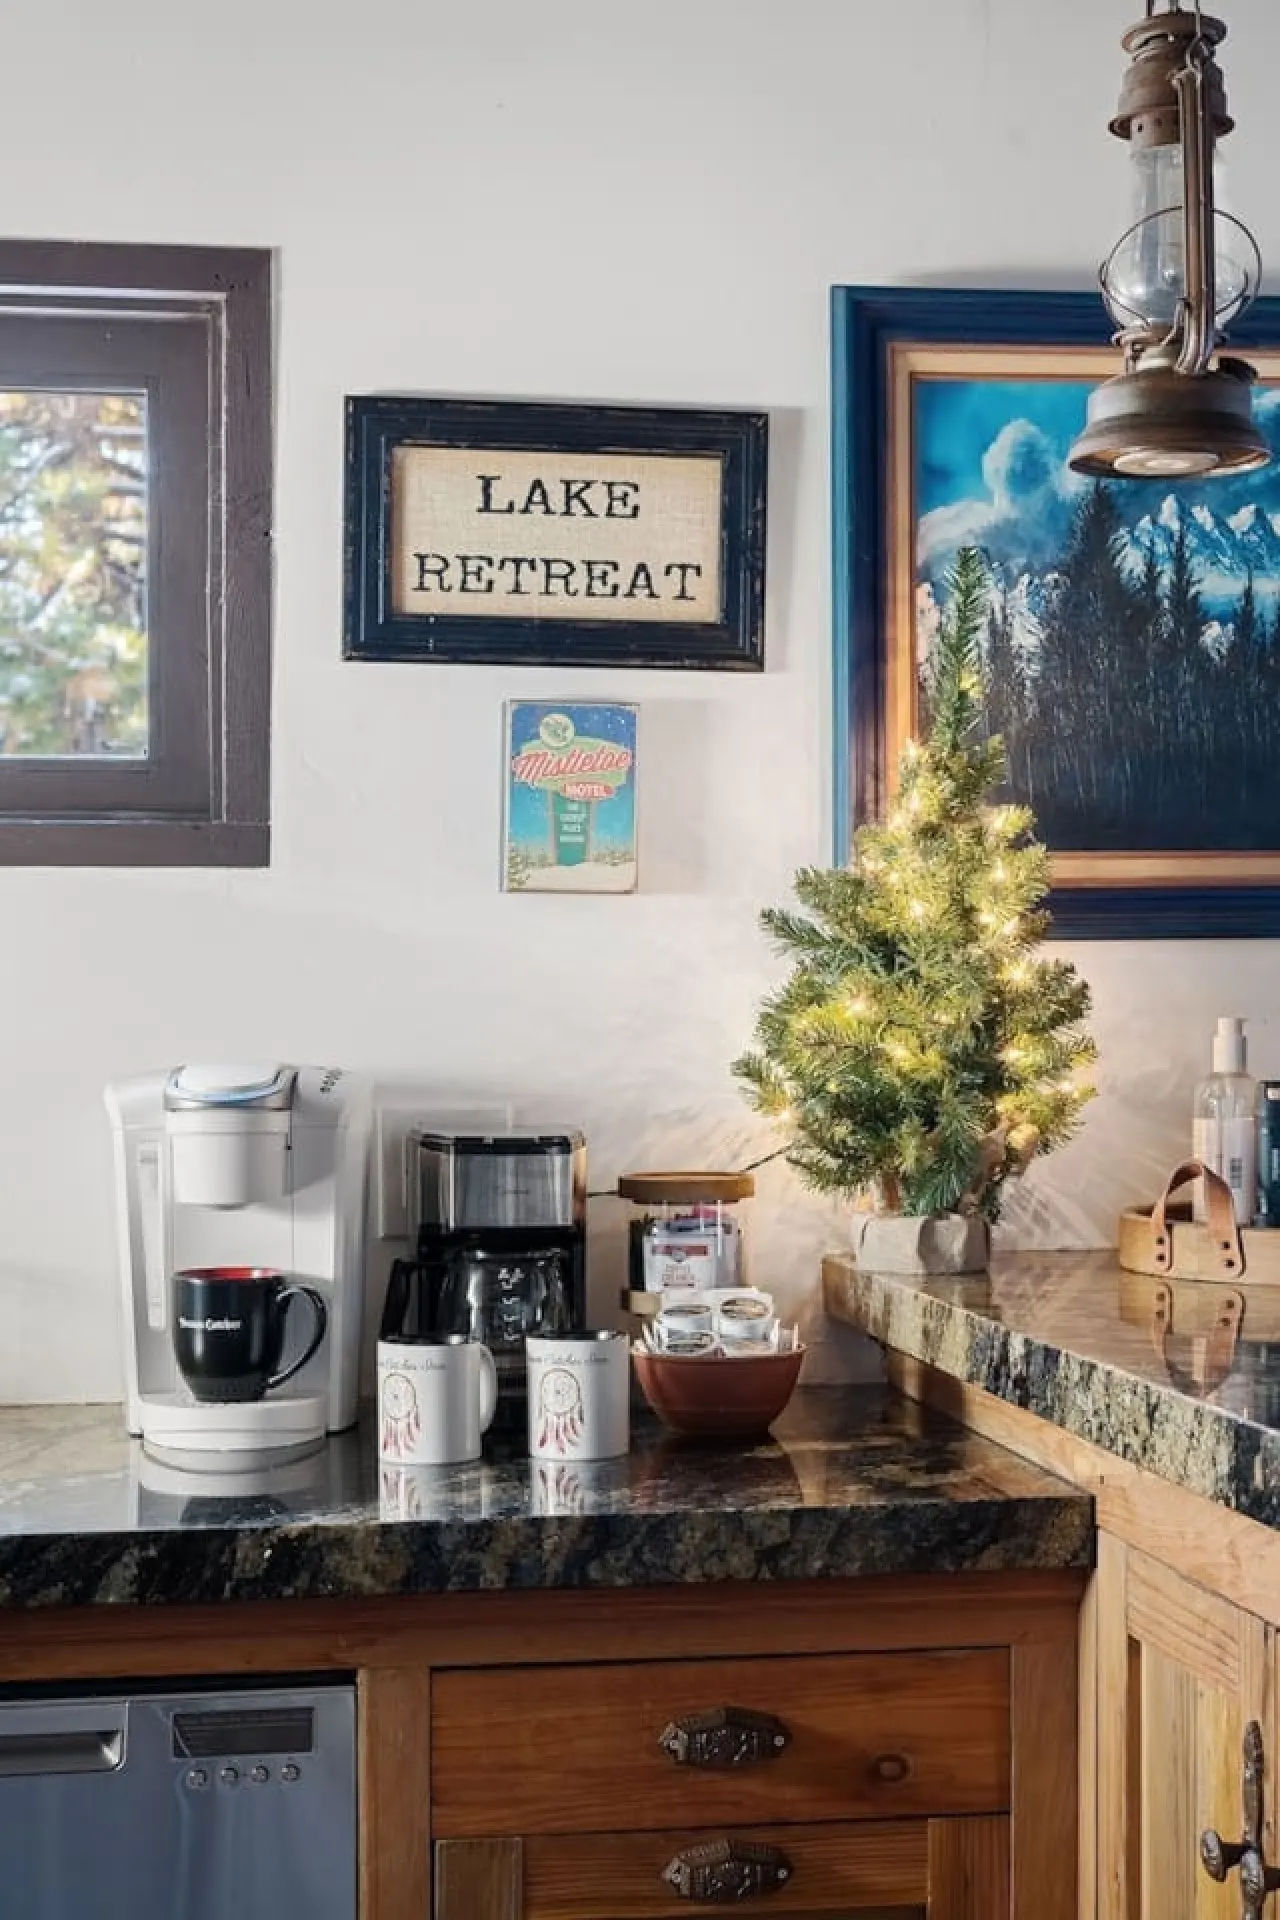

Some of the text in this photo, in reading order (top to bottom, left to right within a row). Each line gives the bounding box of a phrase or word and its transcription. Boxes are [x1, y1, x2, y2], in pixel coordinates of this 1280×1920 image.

[476, 475, 641, 519] LAKE
[411, 553, 703, 601] RETREAT
[512, 745, 632, 783] Mistletoe
[565, 783, 605, 797] MOTEL
